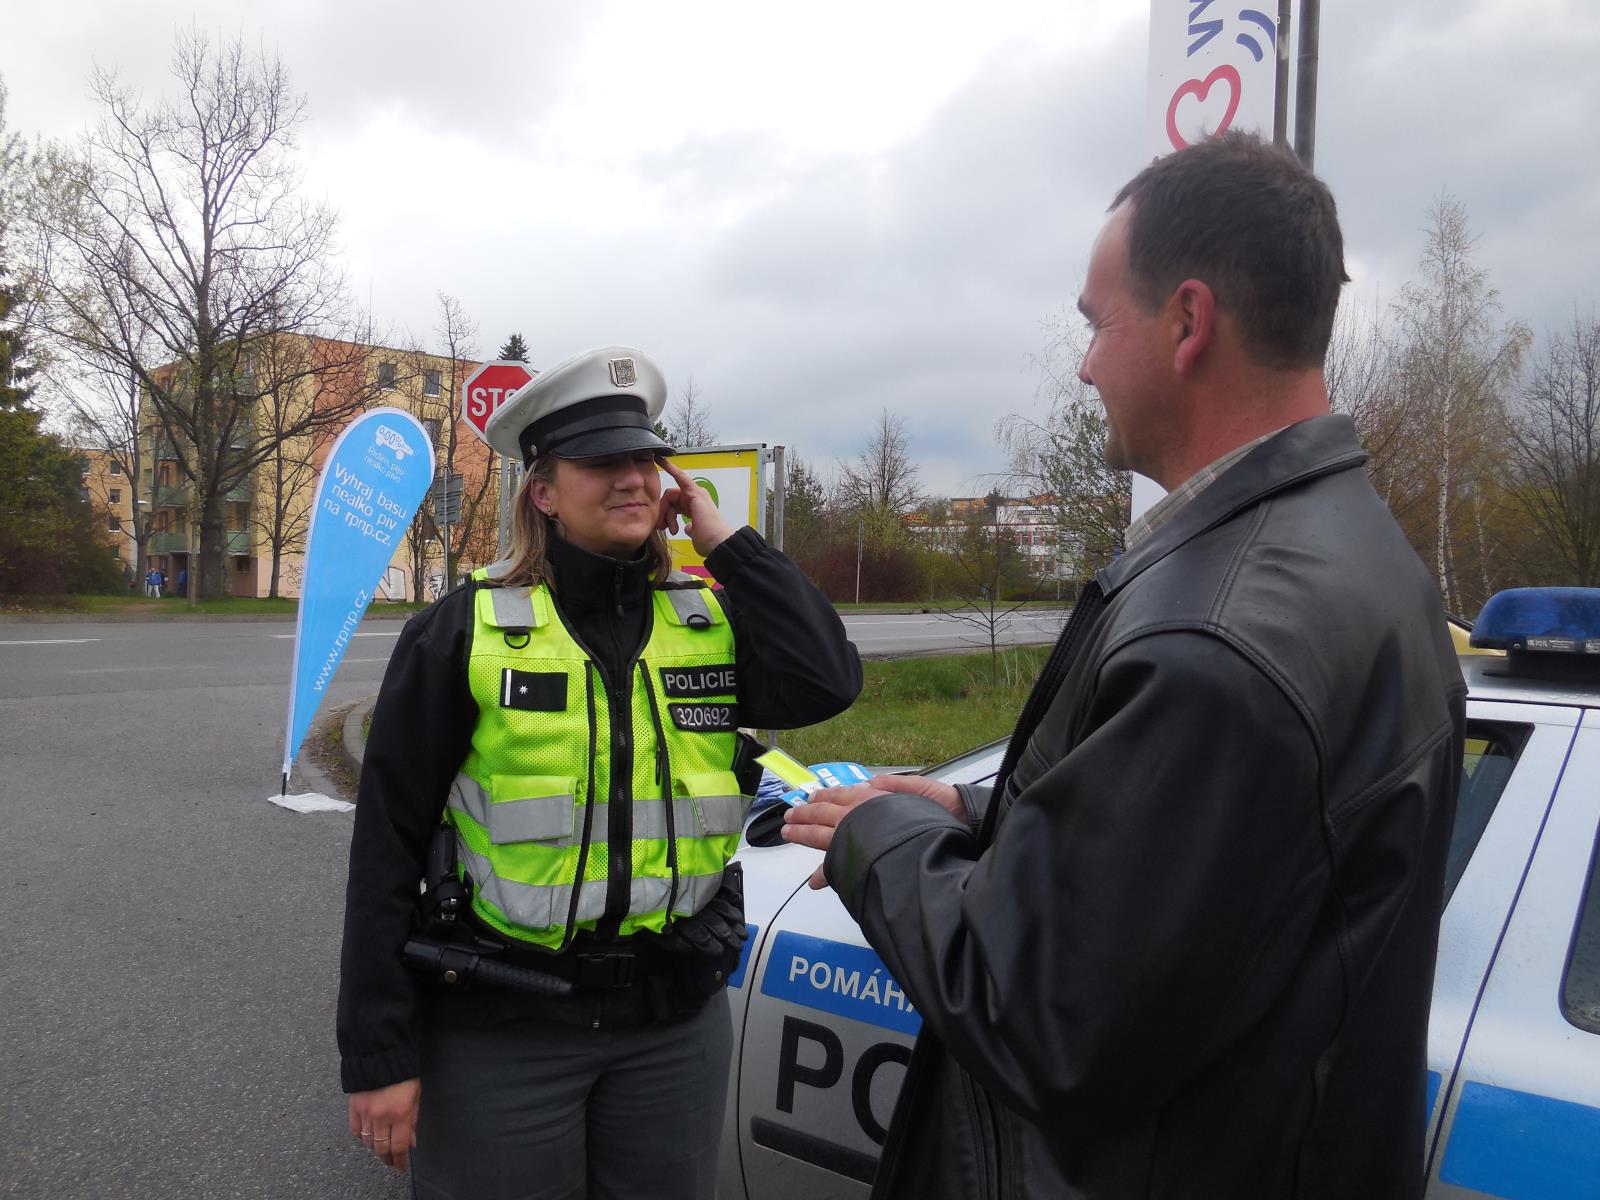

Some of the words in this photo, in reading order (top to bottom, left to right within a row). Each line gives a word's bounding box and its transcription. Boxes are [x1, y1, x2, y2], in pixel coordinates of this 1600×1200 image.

[331, 485, 374, 517] nealko
[376, 513, 397, 530] piv
[335, 462, 373, 501] Vyhraj
[377, 490, 407, 519] basu
[324, 498, 341, 516] na
[344, 511, 391, 547] rpnp.cz.
[313, 588, 369, 691] www.rpnp.cz
[665, 670, 736, 691] POLICIE
[677, 707, 731, 726] 320692
[788, 954, 915, 1013] POMÁH
